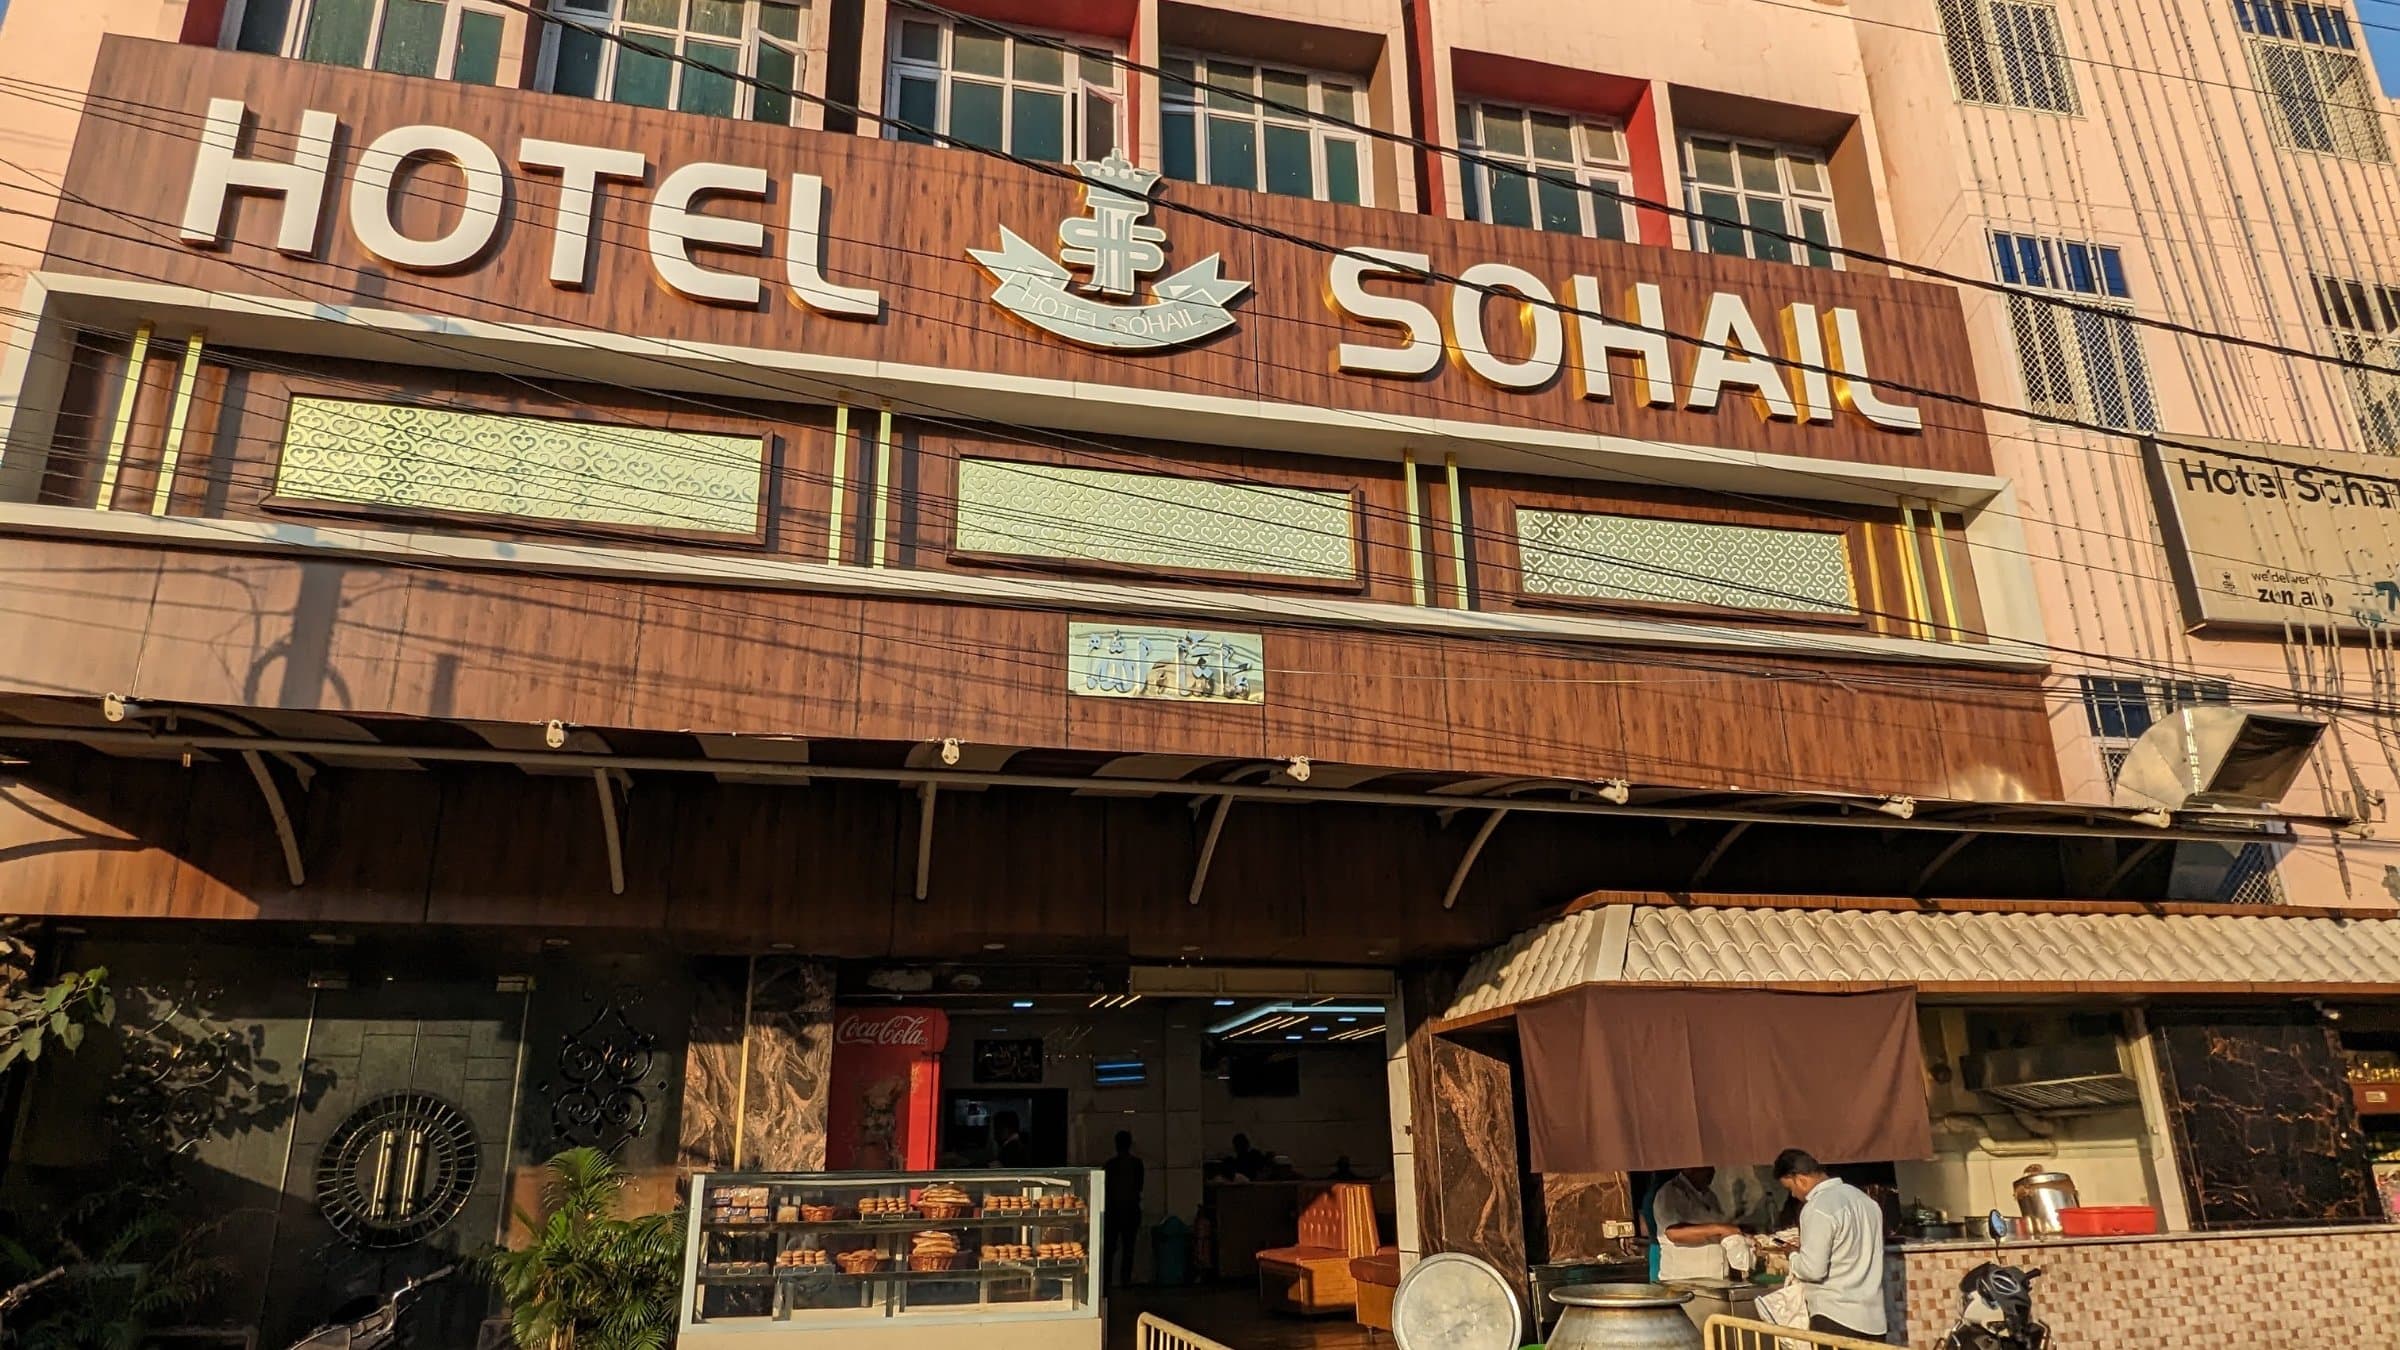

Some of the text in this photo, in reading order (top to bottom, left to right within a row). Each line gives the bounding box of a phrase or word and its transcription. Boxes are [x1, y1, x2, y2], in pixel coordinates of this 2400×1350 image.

[180, 98, 1922, 432] HOTEL SOHAIL
[1020, 287, 1202, 336] HOTEL SOHAIL
[2179, 458, 2287, 499] Hotel
[836, 1015, 929, 1045] Coca-Cola
